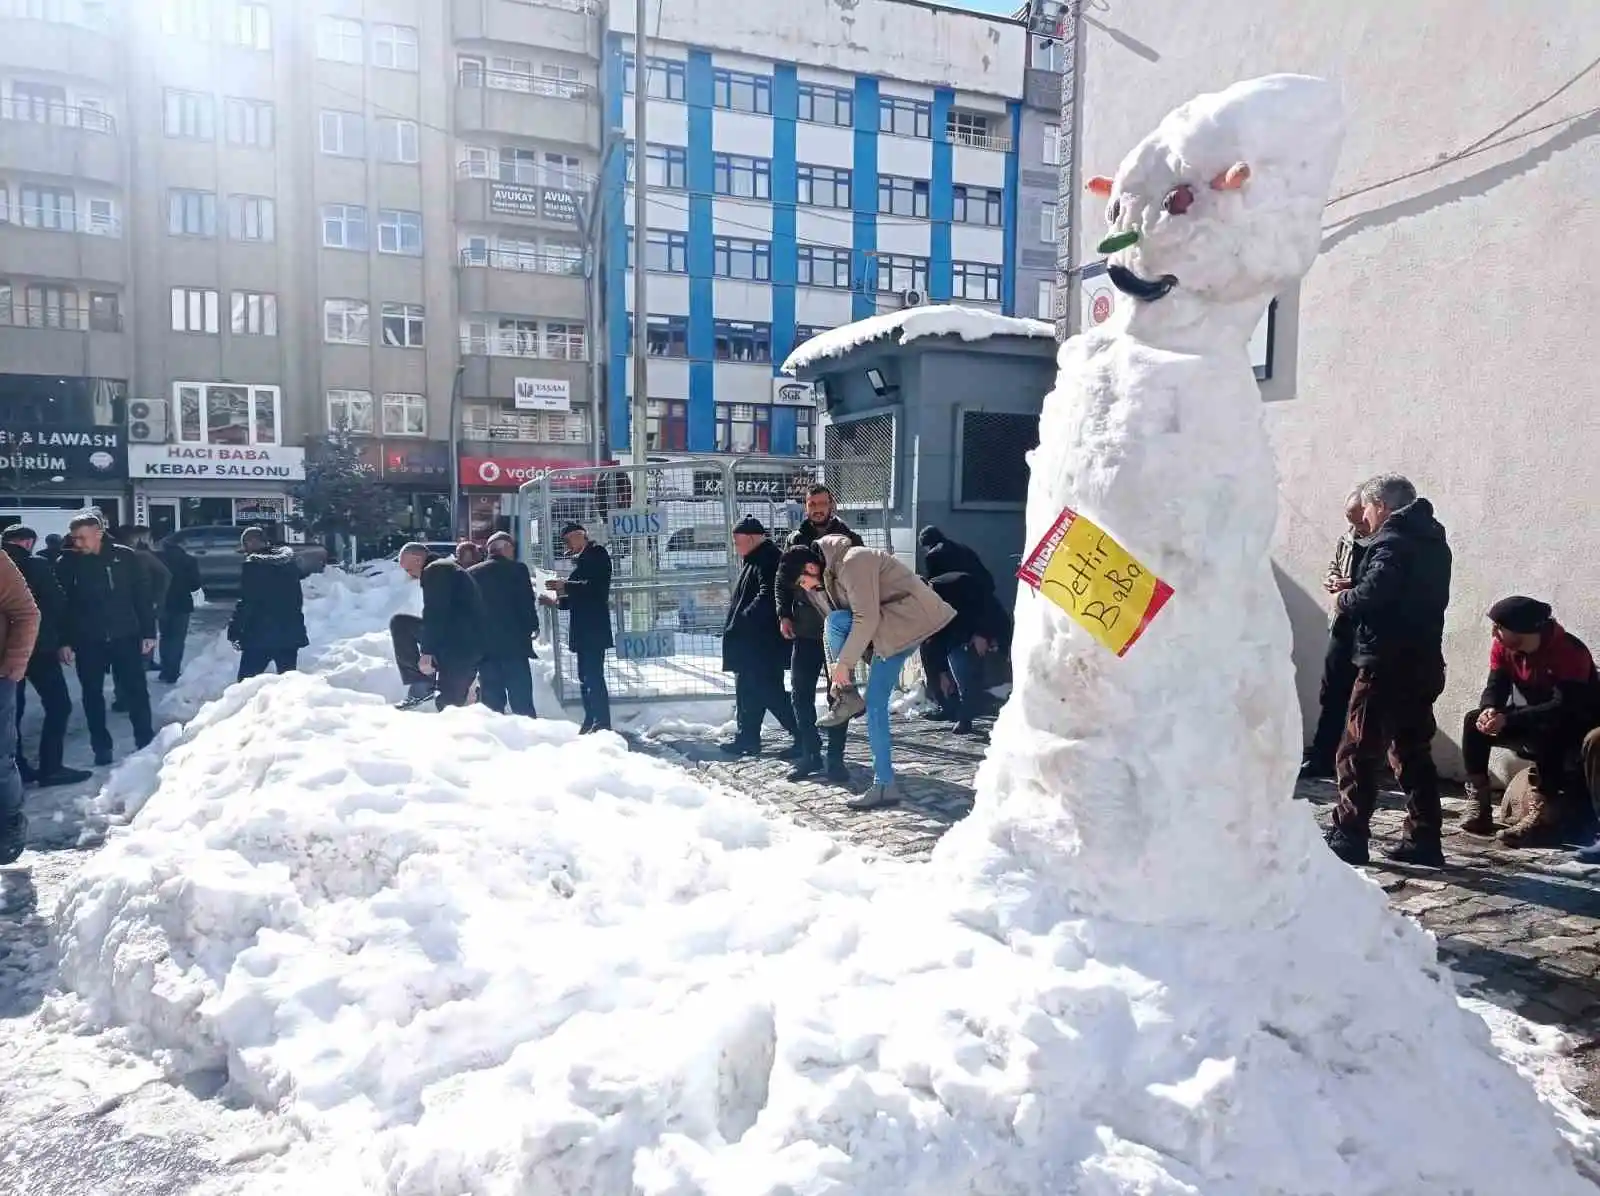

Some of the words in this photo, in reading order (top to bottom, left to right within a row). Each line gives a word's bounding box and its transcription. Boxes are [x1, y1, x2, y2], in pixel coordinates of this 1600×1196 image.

[494, 190, 534, 202] AVUKAT
[544, 191, 584, 205] AVUKT
[38, 431, 117, 448] LAWASH
[0, 452, 66, 470] DÜRÜM
[168, 447, 212, 459] HACI
[219, 449, 270, 461] BABA
[145, 463, 208, 475] KEBAP
[215, 464, 290, 477] SALONU
[737, 479, 778, 493] BEYAZ
[612, 509, 660, 535] POLİS
